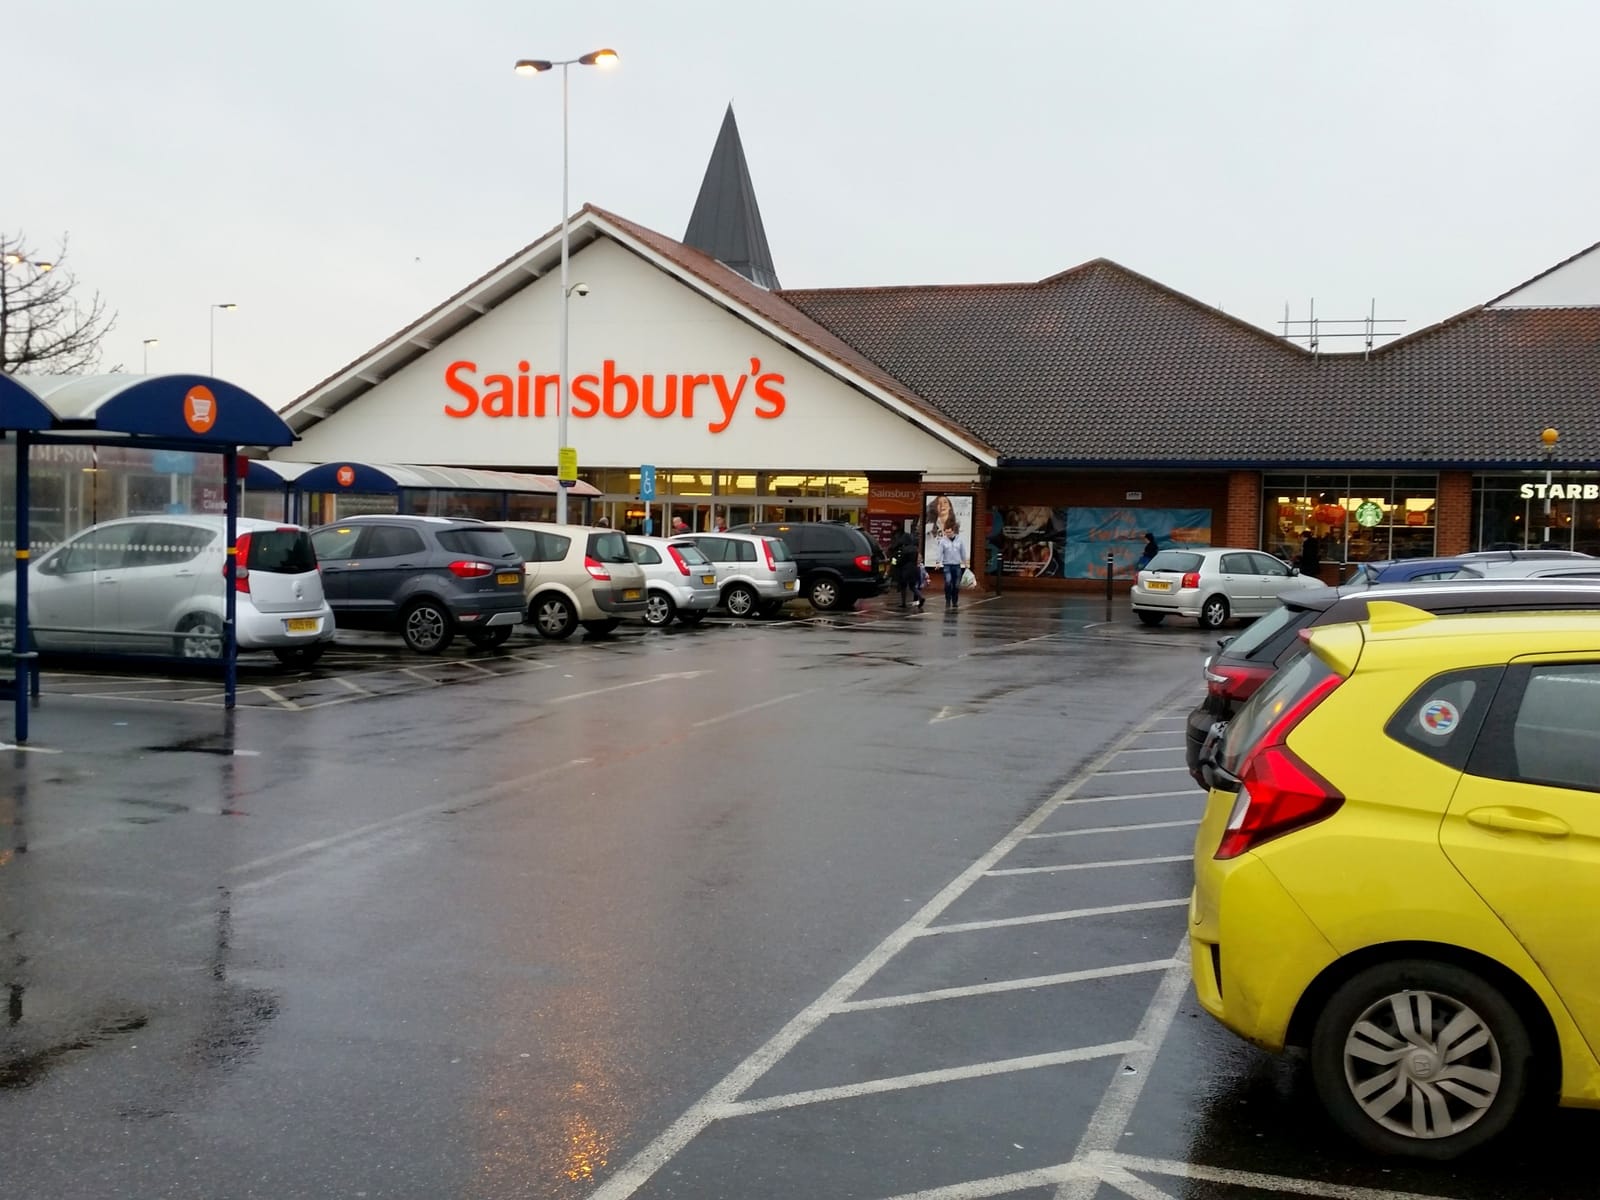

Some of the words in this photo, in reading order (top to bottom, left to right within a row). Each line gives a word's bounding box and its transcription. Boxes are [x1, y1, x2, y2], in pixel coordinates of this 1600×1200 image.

[444, 357, 786, 433] Sainsbury's
[28, 444, 102, 464] IMPSON
[1520, 483, 1599, 499] STARB
